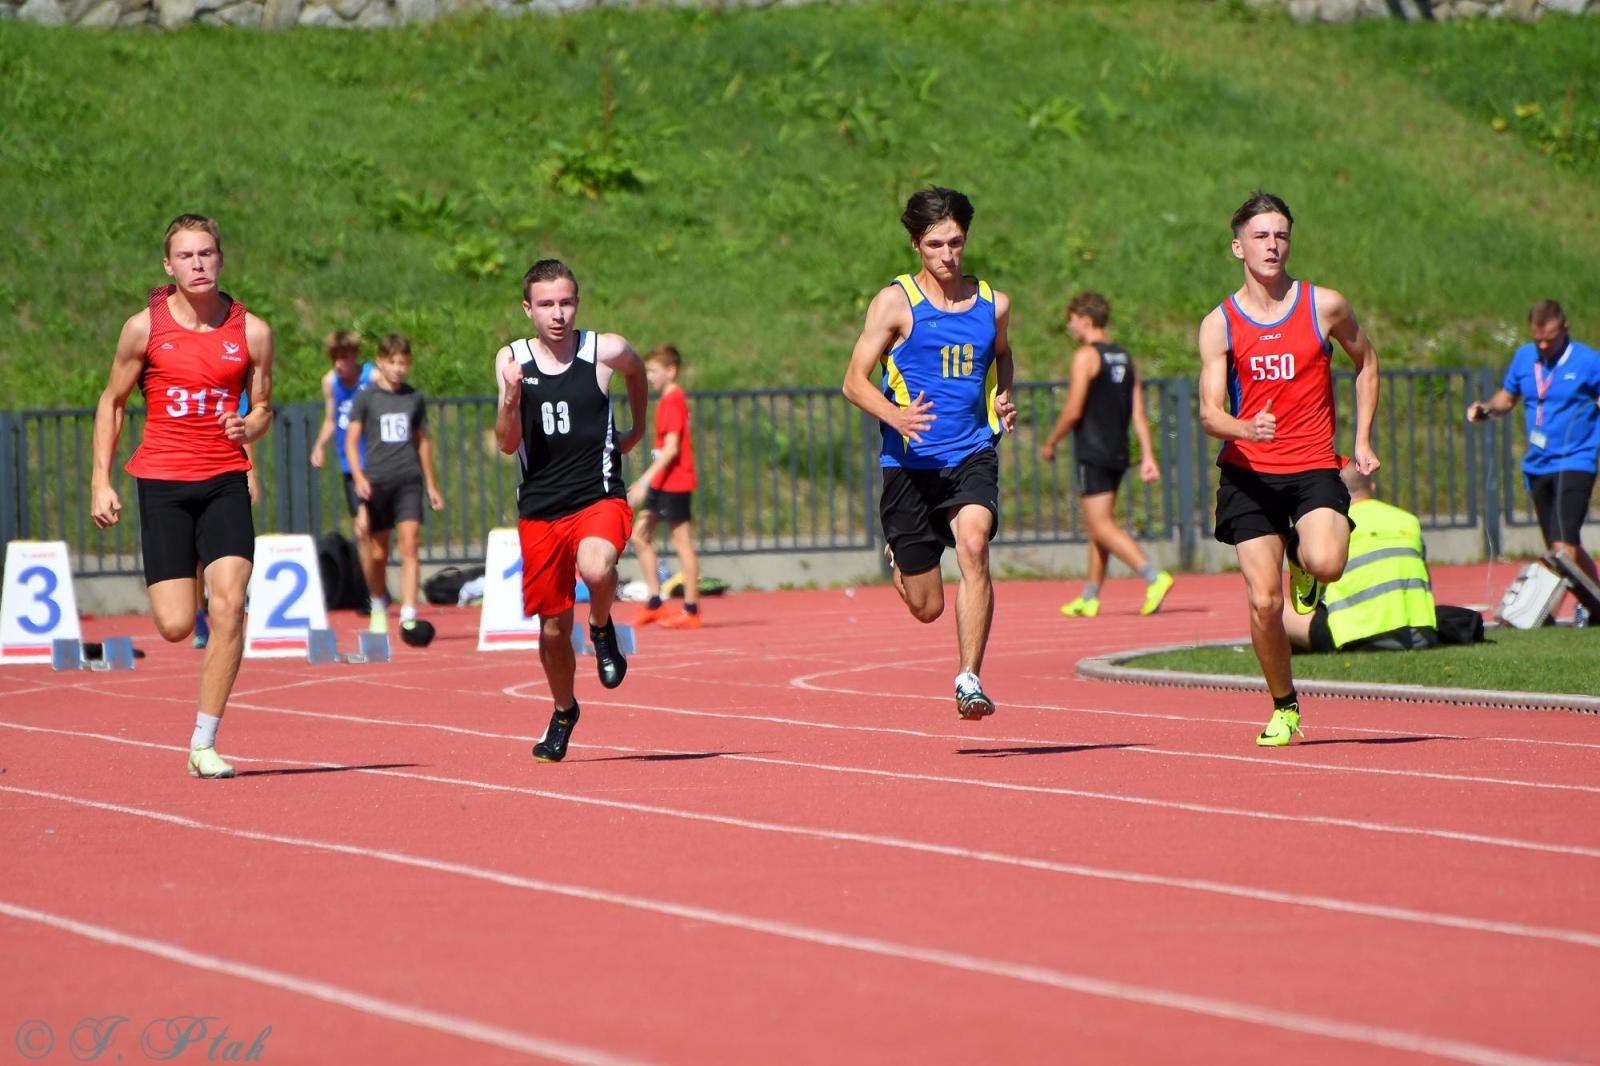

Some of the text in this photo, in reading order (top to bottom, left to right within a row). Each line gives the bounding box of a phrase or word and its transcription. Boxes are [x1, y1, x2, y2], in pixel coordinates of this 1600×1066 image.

[940, 343, 974, 378] 113
[1250, 353, 1295, 380] 550
[166, 386, 229, 417] 317
[541, 401, 571, 435] 63
[382, 416, 407, 439] 16
[17, 566, 61, 634] 3
[265, 561, 310, 629] 2
